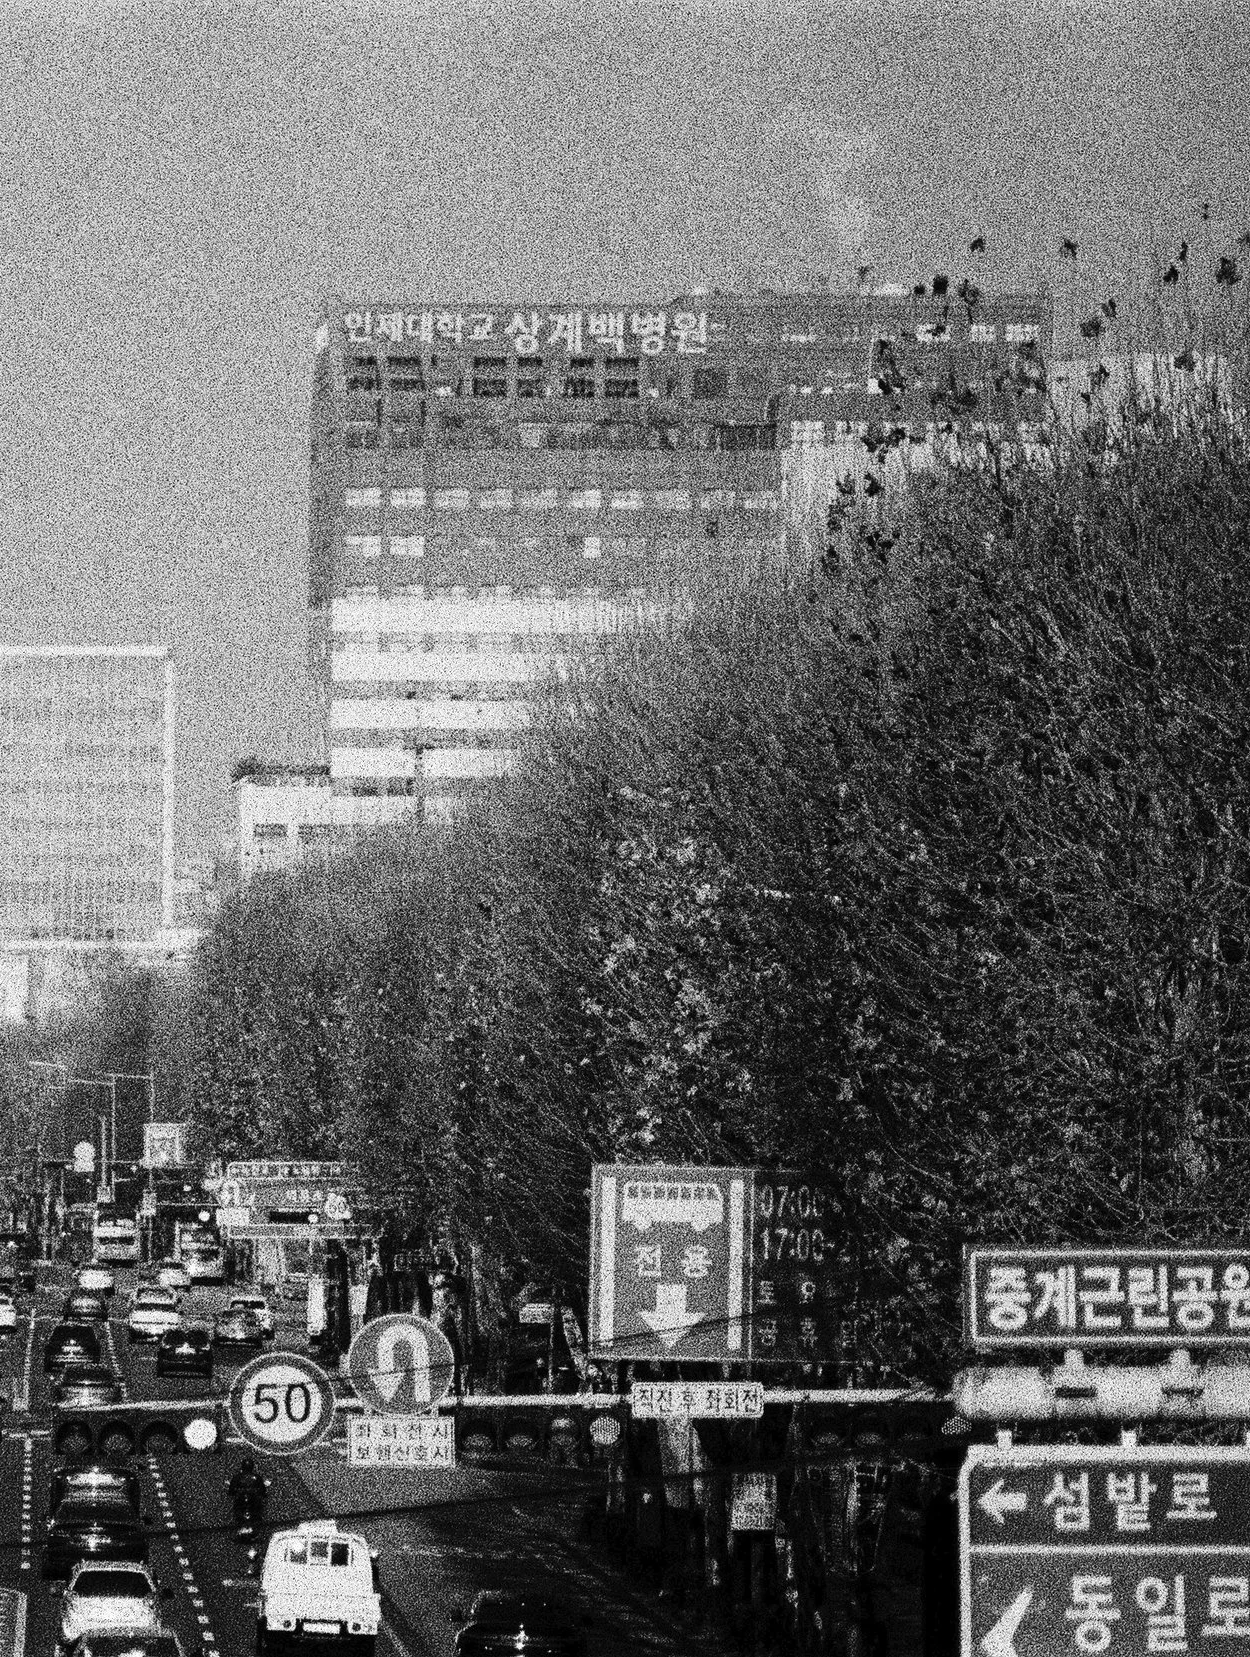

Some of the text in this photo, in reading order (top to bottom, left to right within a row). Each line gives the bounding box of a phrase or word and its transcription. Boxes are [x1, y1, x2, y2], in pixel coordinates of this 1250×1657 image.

[344, 311, 707, 355] 인제대학교 상계백병원
[253, 1383, 312, 1424] 50
[1065, 1575, 1250, 1654] 동일로
